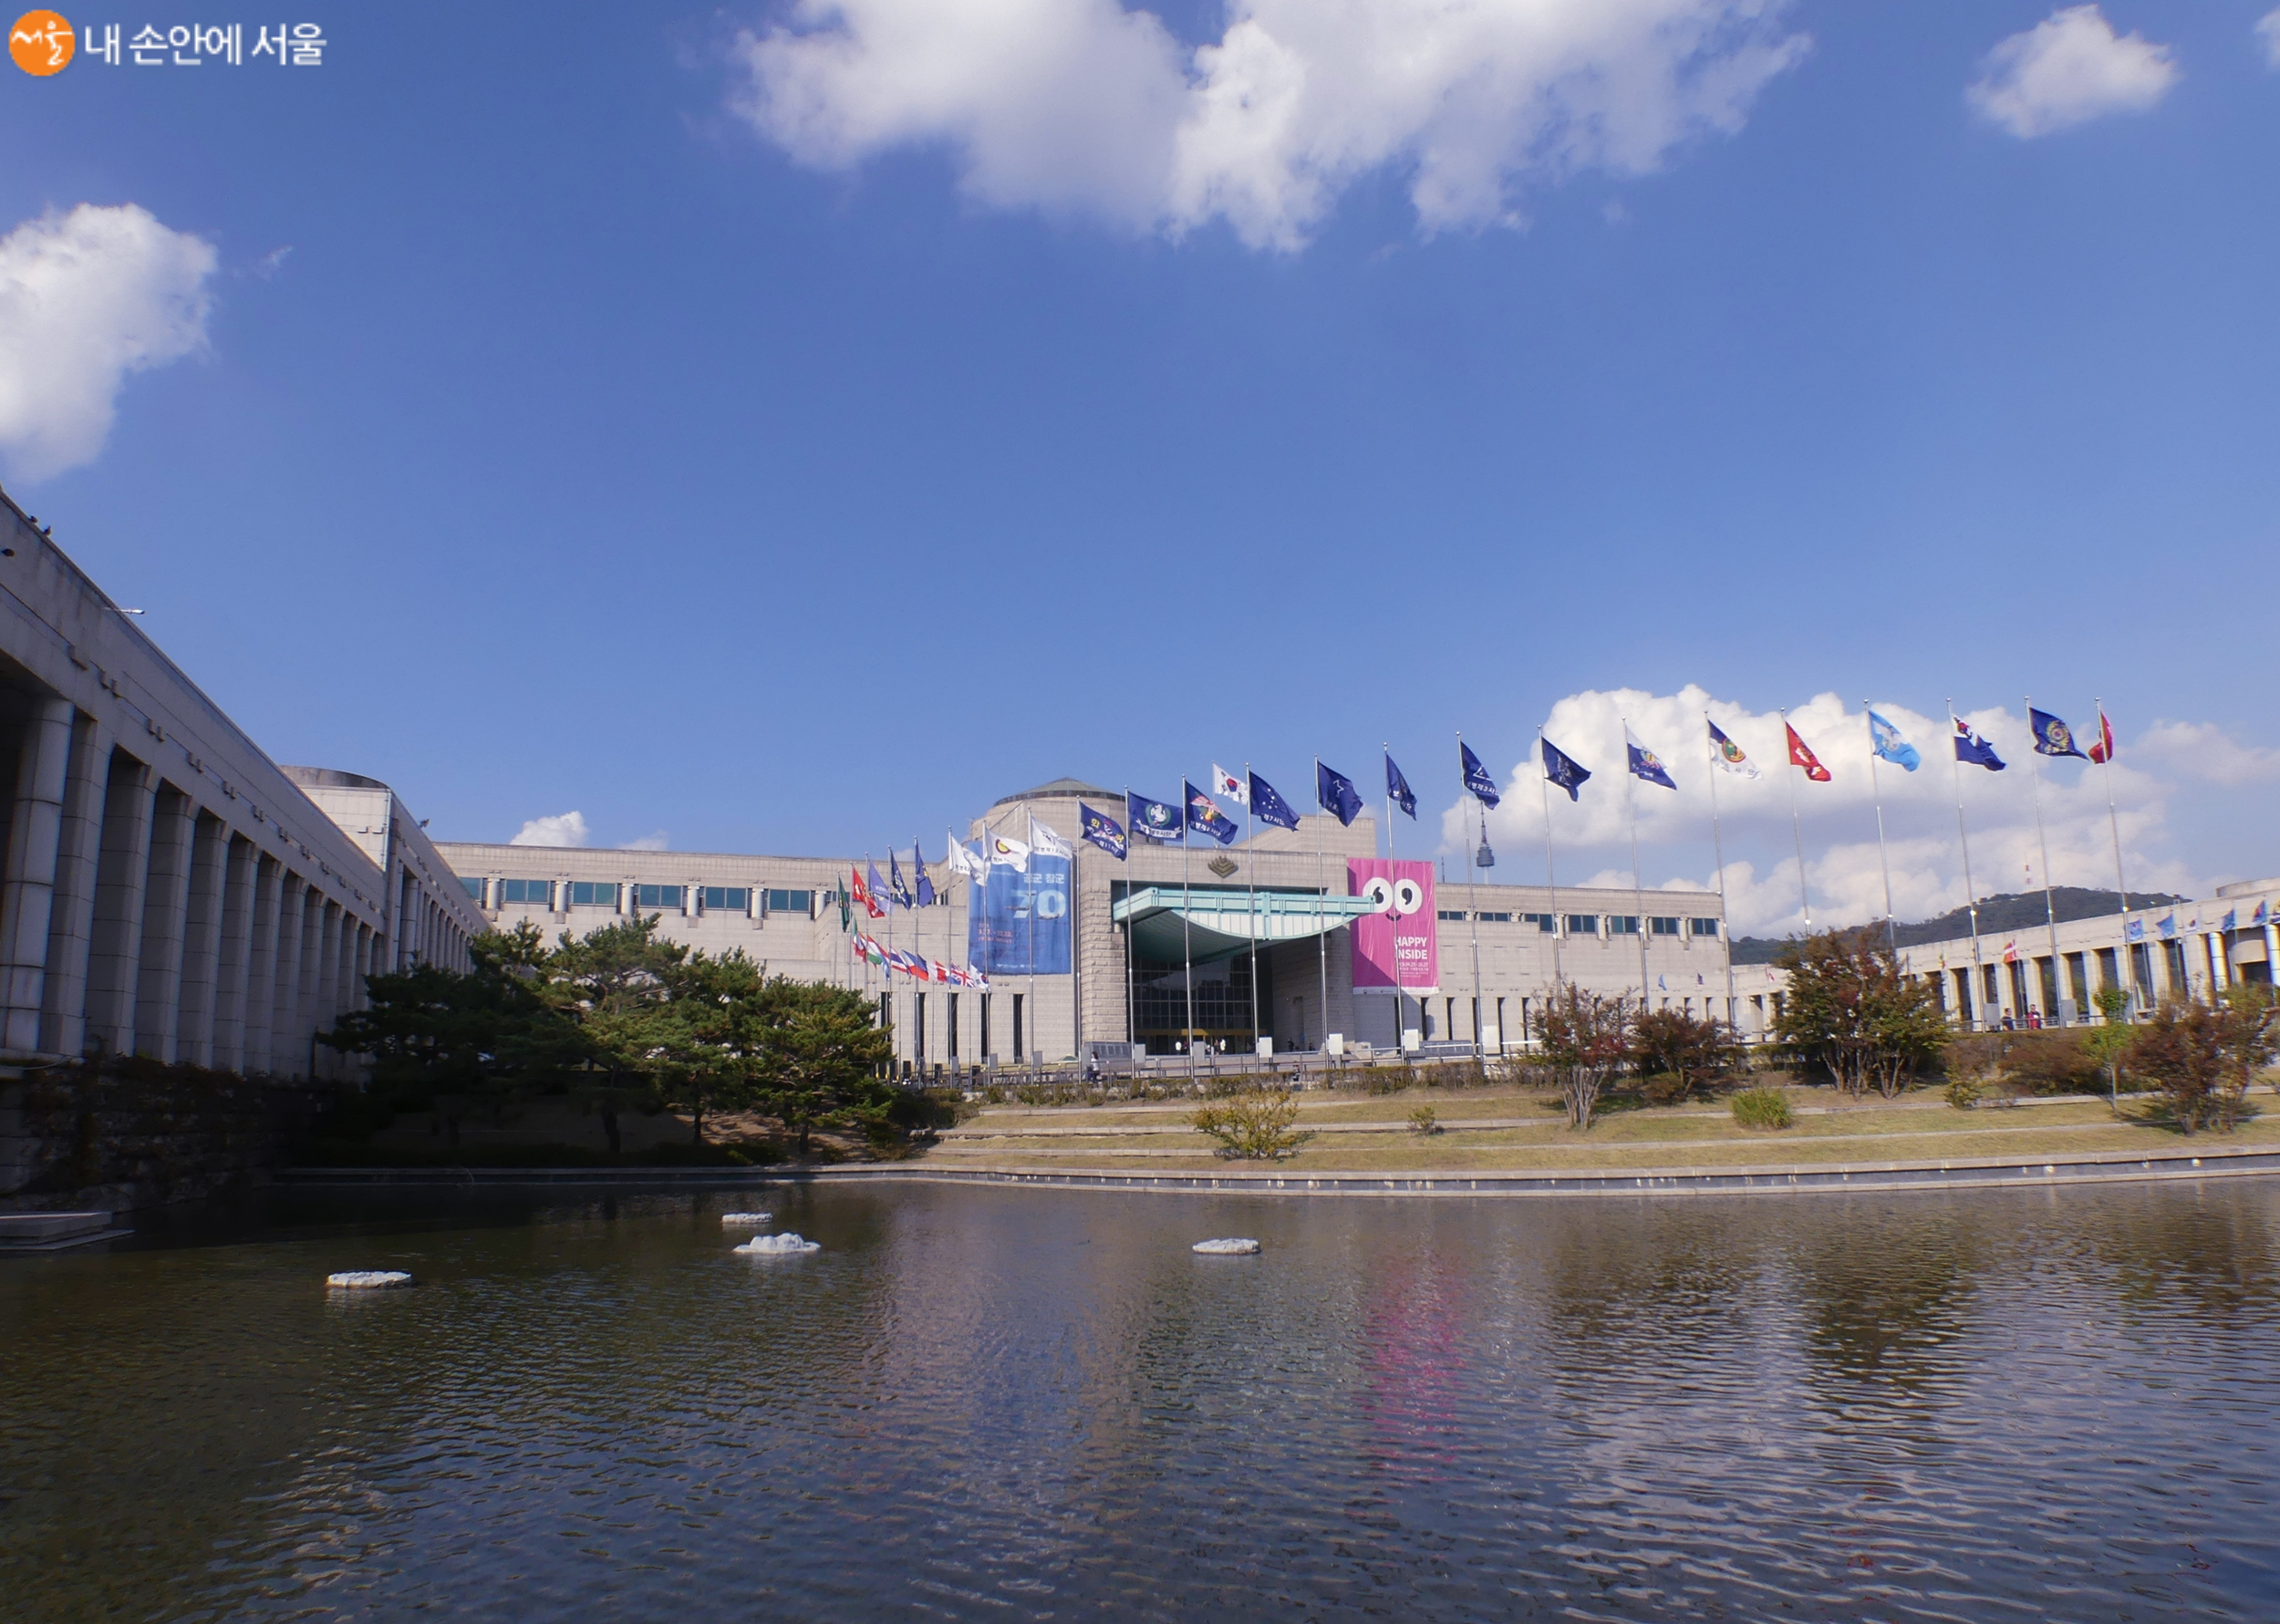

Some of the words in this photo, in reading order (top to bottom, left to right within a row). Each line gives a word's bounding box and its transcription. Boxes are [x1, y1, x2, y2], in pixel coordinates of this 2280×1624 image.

[1046, 873, 1065, 884] 창군
[1011, 889, 1067, 919] 70
[1396, 936, 1427, 947] HAPPY
[1398, 949, 1428, 959] NSIDE
